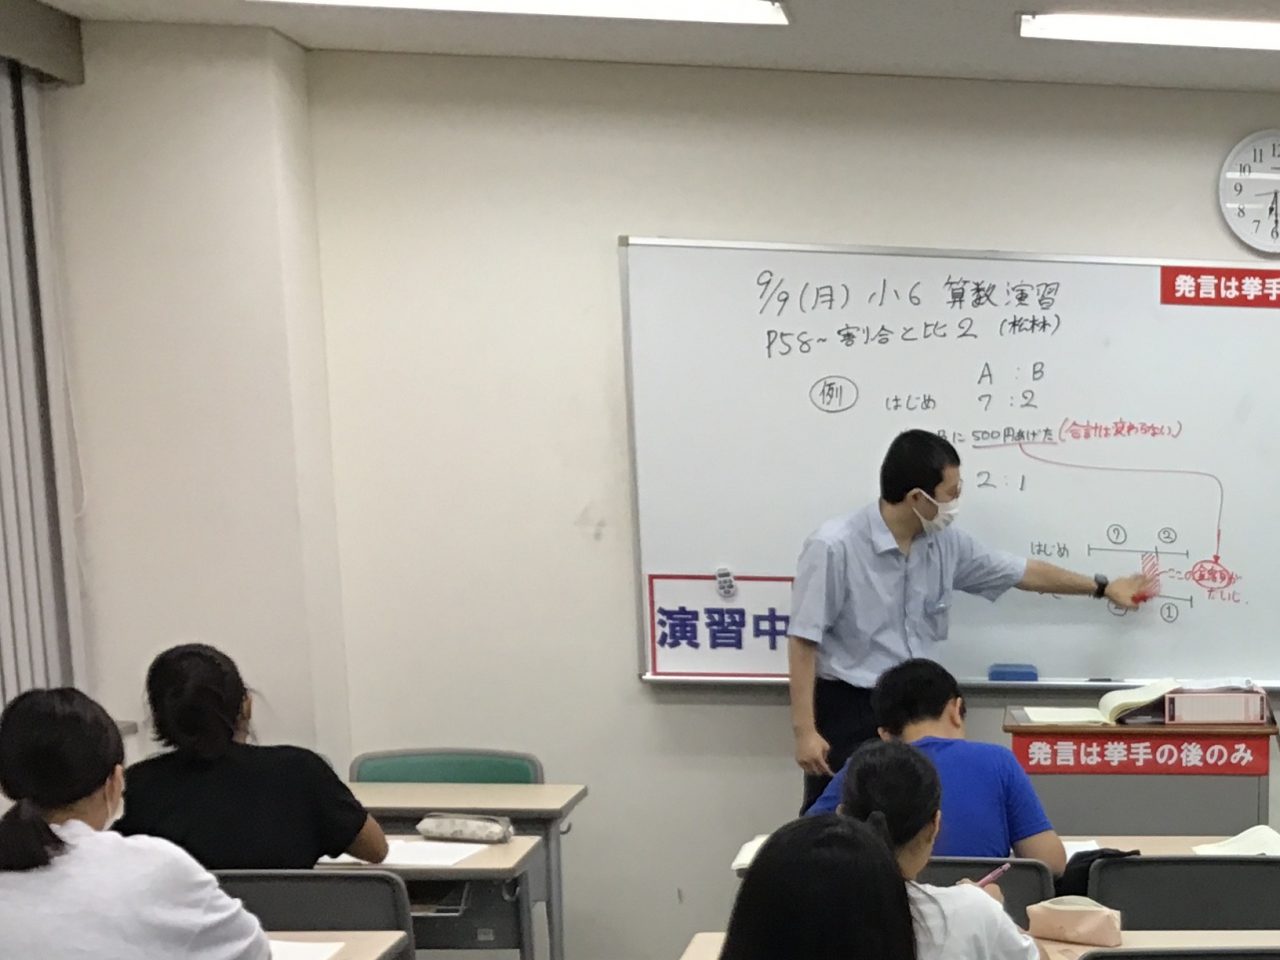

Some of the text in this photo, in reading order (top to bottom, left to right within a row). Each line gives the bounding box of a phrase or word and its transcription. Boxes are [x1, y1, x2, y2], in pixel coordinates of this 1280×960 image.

[1252, 148, 1263, 163] 11
[1239, 163, 1251, 177] 10
[1234, 183, 1243, 197] 9
[1237, 205, 1246, 218] 8
[1252, 220, 1261, 234] 7
[1270, 225, 1280, 240] 6
[885, 394, 937, 410] はじめ
[1030, 541, 1069, 559] はじめ
[657, 606, 791, 651] 演習中
[1028, 741, 1253, 767] 発言は挙手の後のみ
